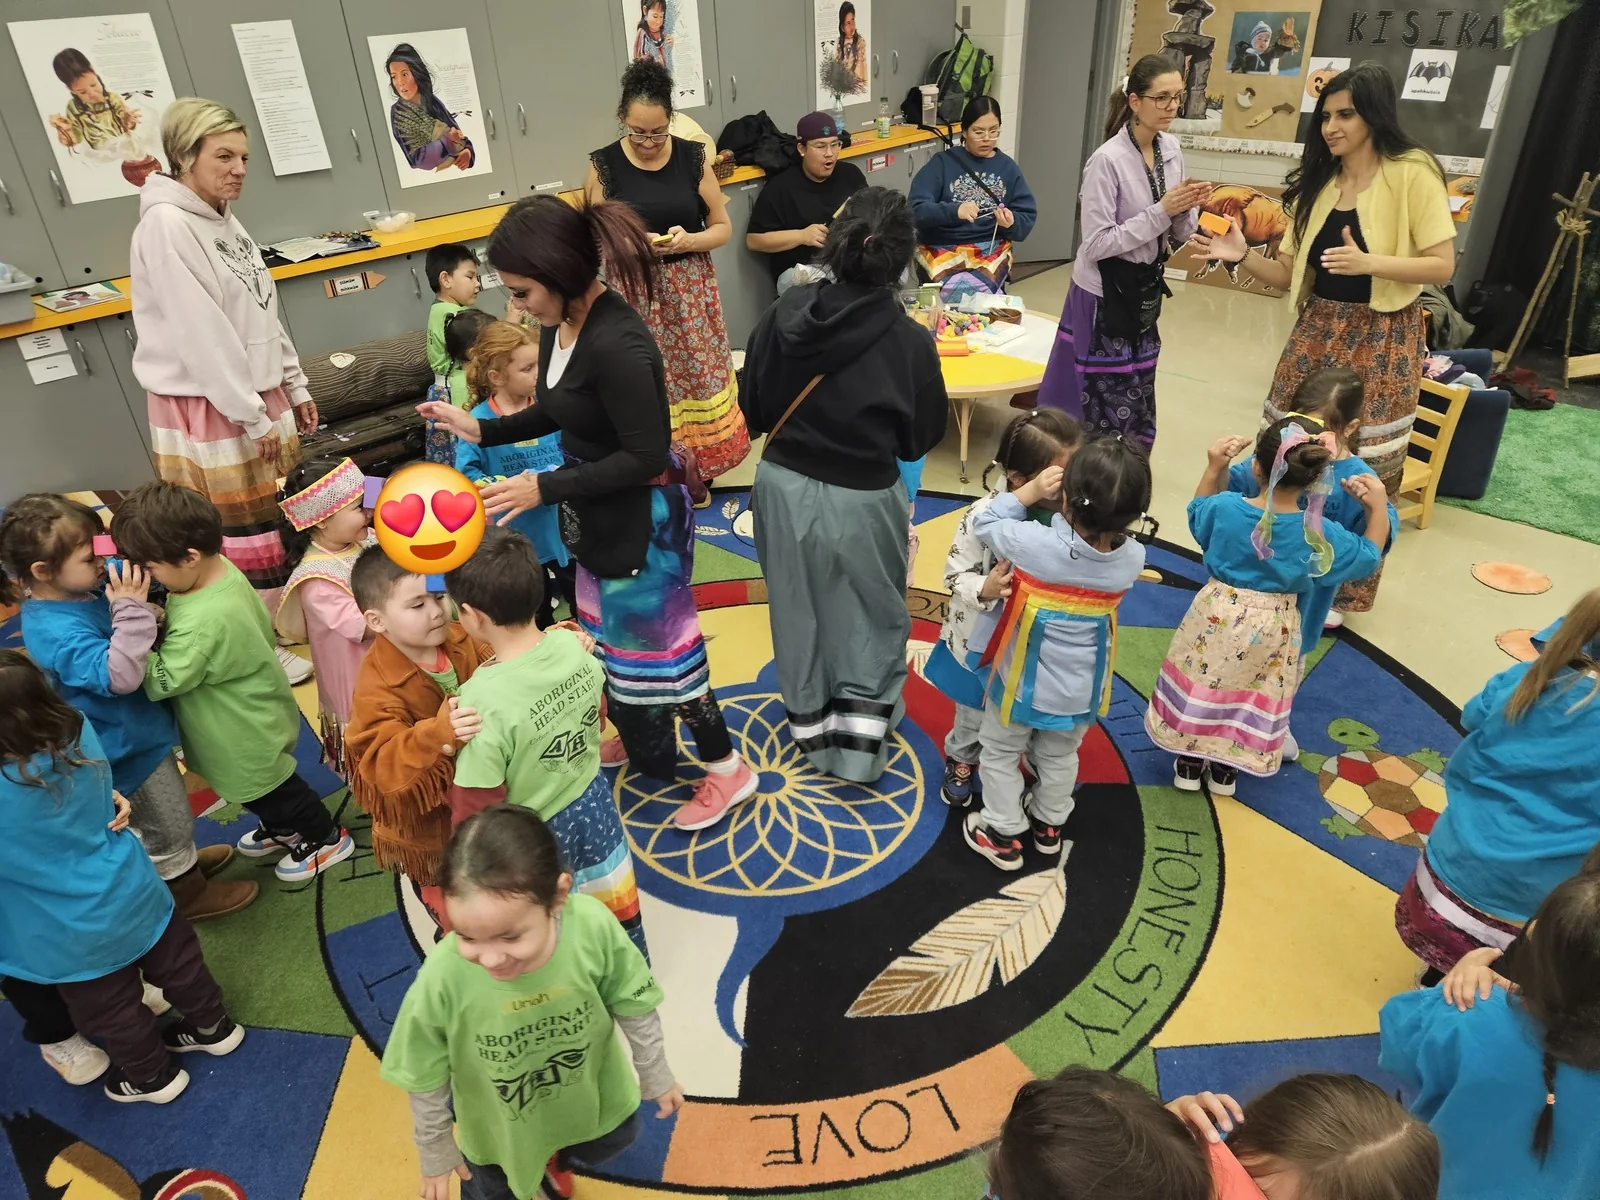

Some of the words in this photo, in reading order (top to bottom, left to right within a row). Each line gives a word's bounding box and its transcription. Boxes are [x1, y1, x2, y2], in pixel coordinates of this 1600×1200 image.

[499, 444, 557, 463] ABORIGINA
[529, 663, 593, 719] ABORIGINAL
[533, 700, 565, 732] HEAD
[567, 676, 596, 705] START
[1064, 825, 1200, 1055] HONESTY
[475, 1000, 594, 1047] ABORIGINAL
[478, 1040, 529, 1063] HEAD
[535, 1011, 593, 1045] START
[750, 1082, 960, 1167] LOVE
